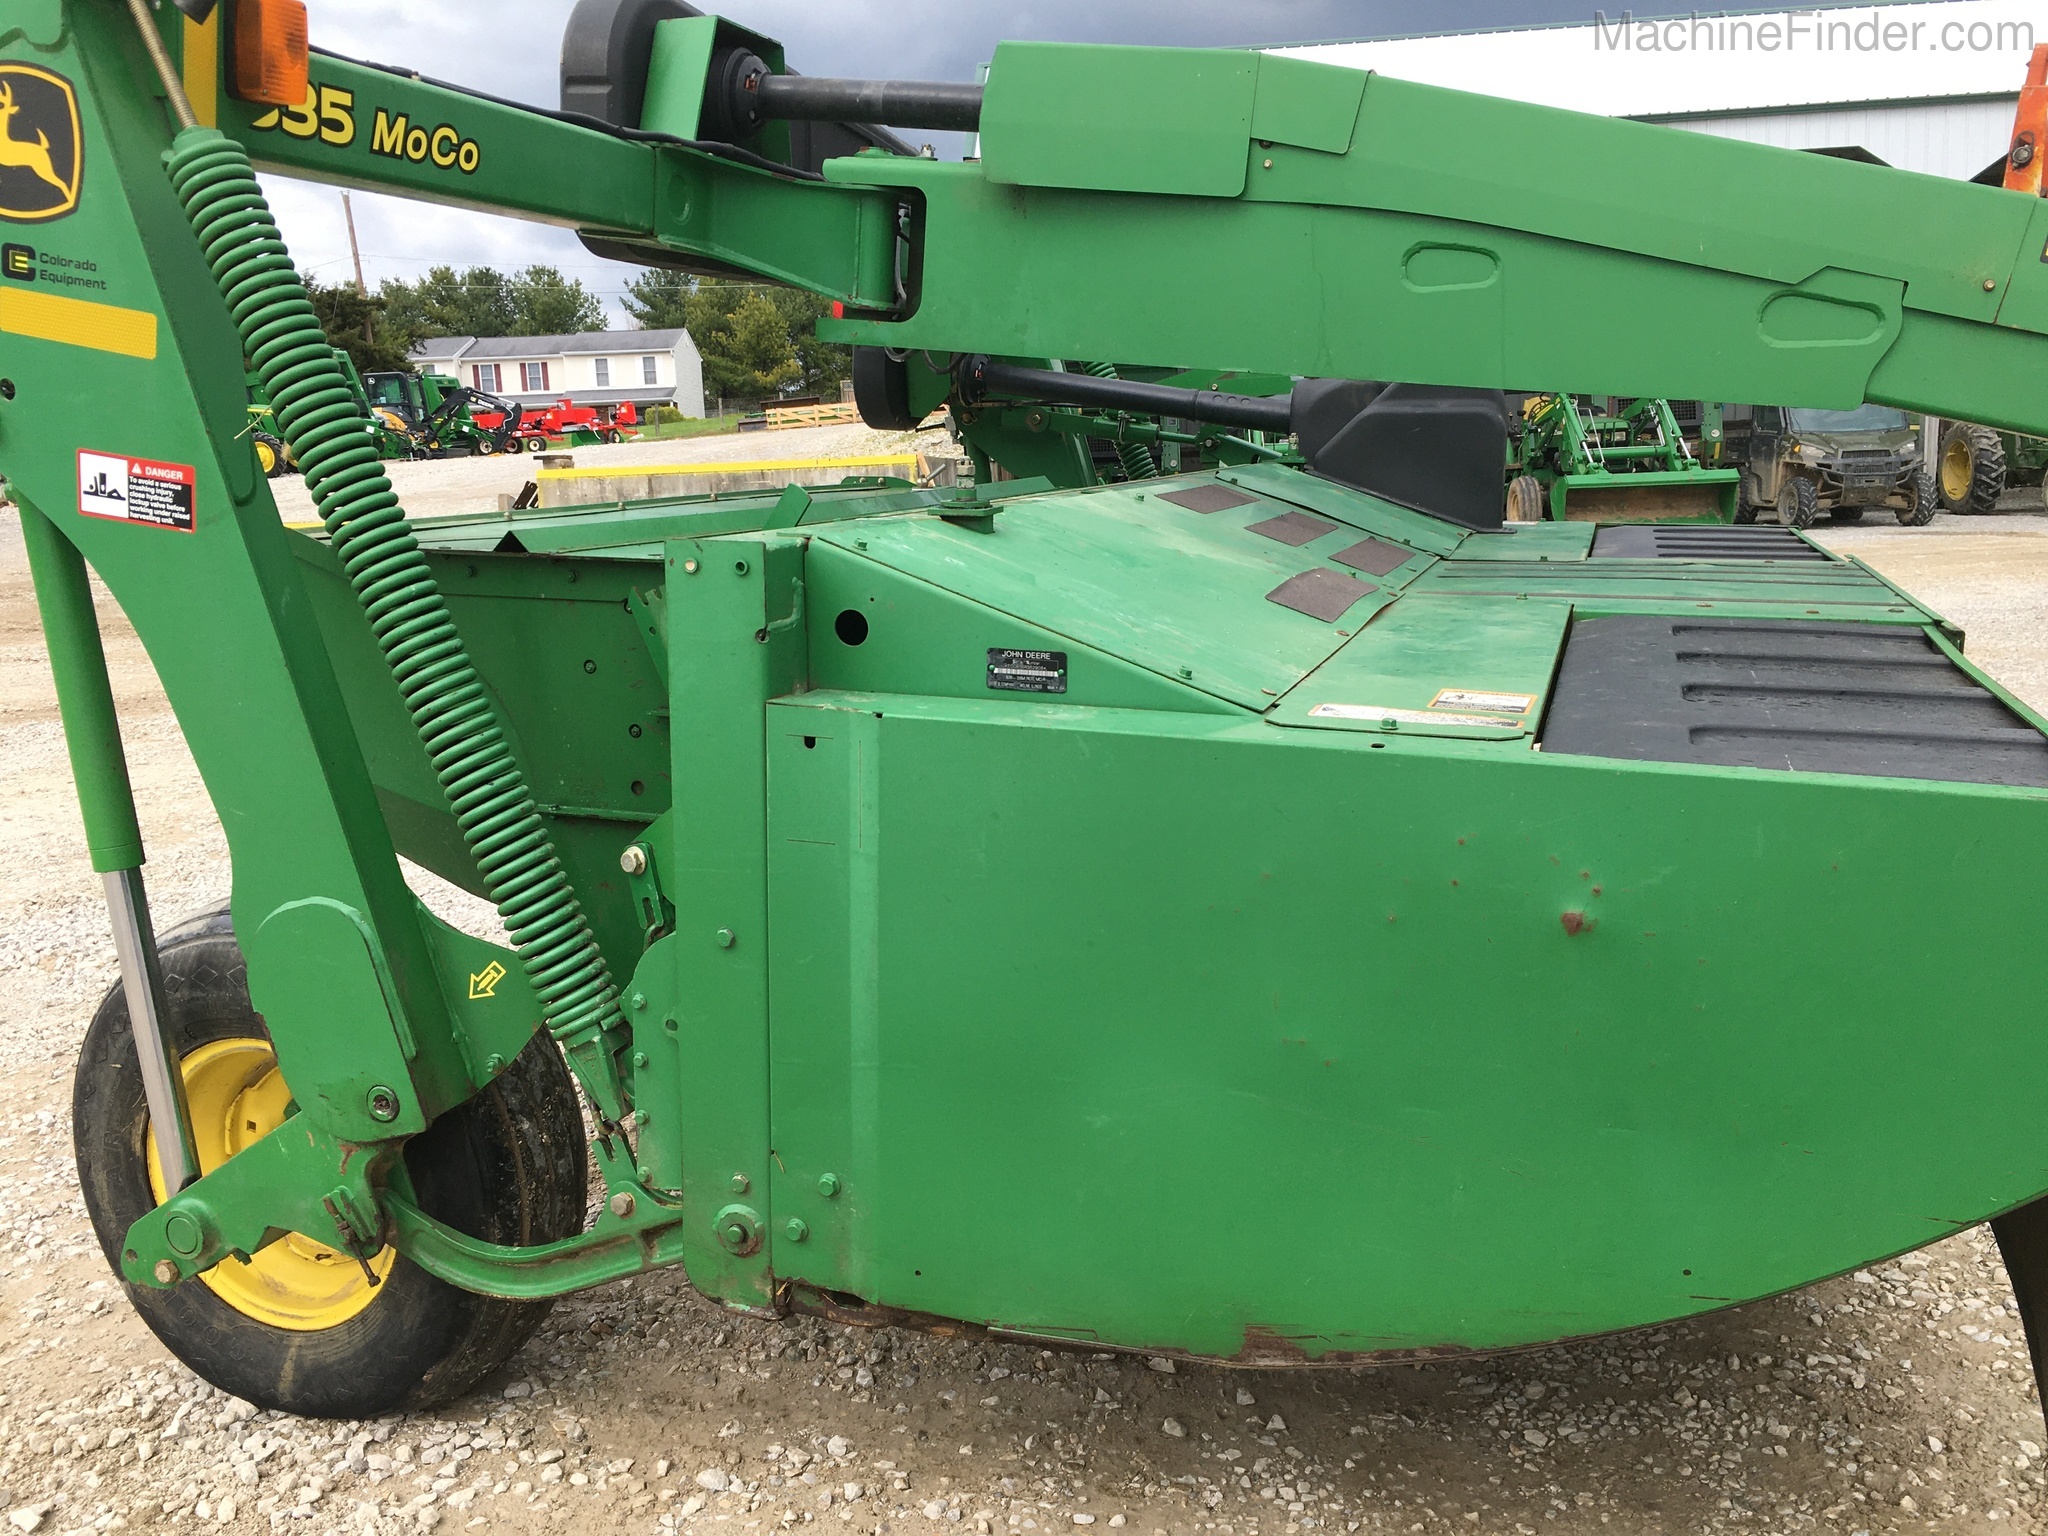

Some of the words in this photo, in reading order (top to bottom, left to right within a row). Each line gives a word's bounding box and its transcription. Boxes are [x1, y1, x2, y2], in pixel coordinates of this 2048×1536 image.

[371, 110, 479, 172] MoCo
[39, 252, 97, 272] Colorado
[39, 269, 107, 290] Equipment
[145, 466, 183, 480] DANGER
[129, 484, 154, 494] crushing
[156, 489, 174, 498] injury,
[138, 478, 154, 486] avoid
[160, 482, 181, 490] serious
[129, 498, 149, 507] lockup
[150, 502, 166, 510] valve
[167, 504, 185, 512] before
[146, 494, 173, 503] hydraulic
[129, 506, 153, 515] working
[154, 509, 171, 517] under
[172, 512, 190, 521] raised
[129, 512, 160, 523] harvesting
[1002, 650, 1023, 658] JOHN
[1025, 651, 1051, 659] DEERE
